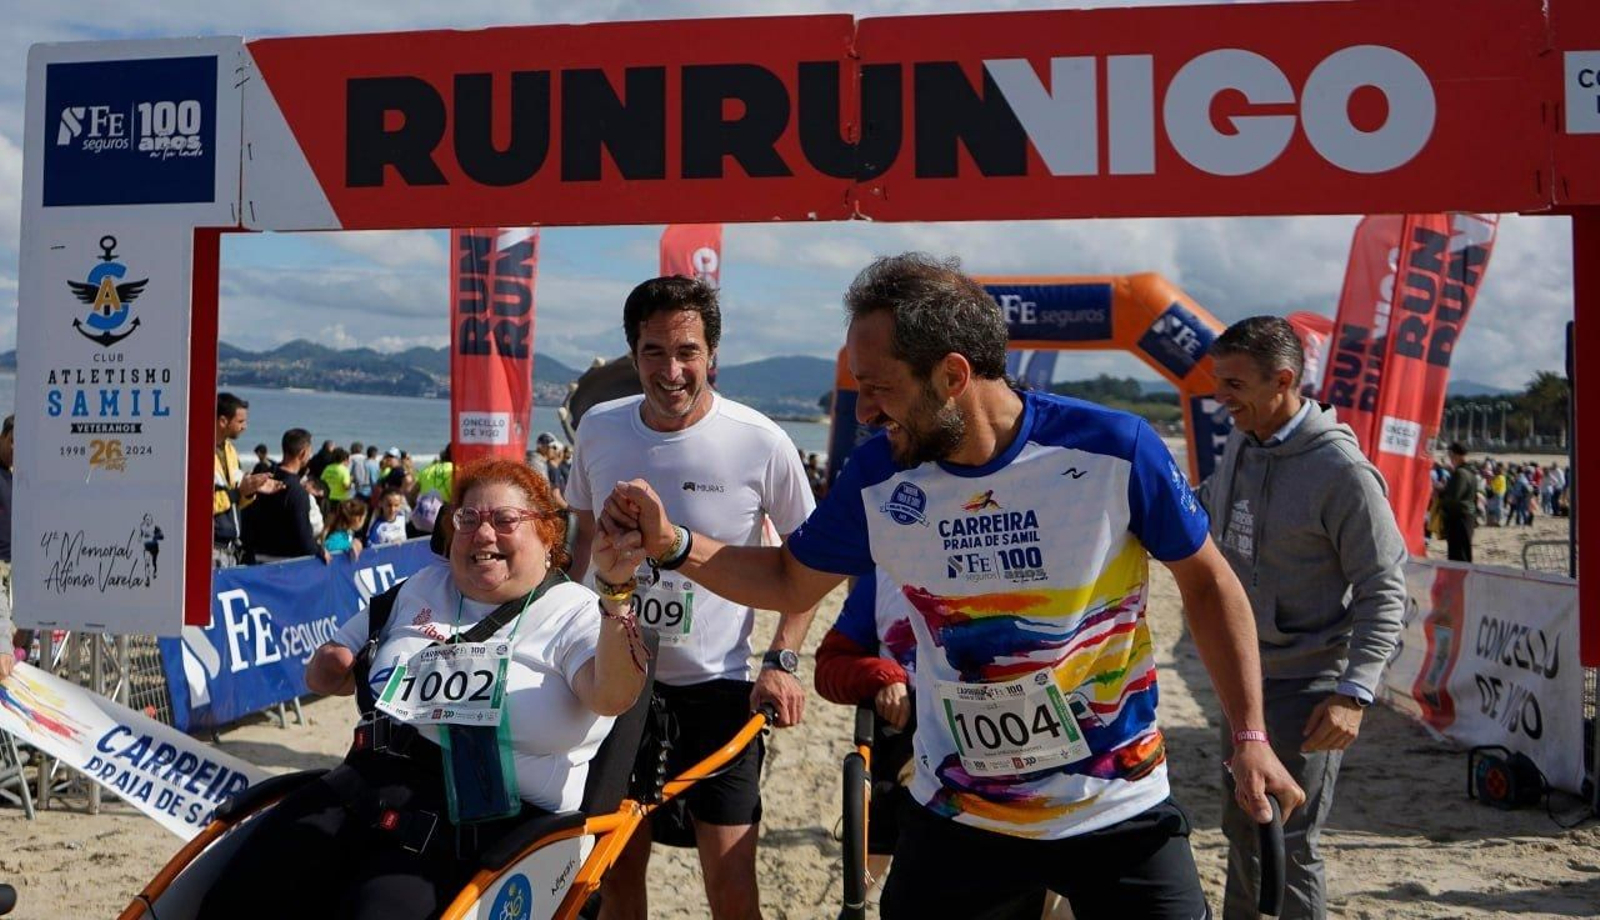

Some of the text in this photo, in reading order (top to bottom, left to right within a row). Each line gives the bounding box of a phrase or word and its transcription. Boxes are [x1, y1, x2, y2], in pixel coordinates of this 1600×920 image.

[138, 100, 201, 136] 100
[83, 137, 129, 153] seguros
[460, 235, 492, 356] RUN
[1396, 226, 1449, 360] RUN
[1040, 309, 1105, 328] seguros
[93, 353, 124, 362] CLUB
[1327, 323, 1370, 408] RUN
[48, 368, 171, 384] ATLETISMO
[48, 389, 170, 417] SAMIL
[77, 424, 136, 432] VETERANOS
[460, 418, 506, 427] ONCELLO
[464, 428, 475, 436] DE
[60, 446, 86, 455] 1998
[89, 439, 123, 465] 26
[126, 445, 153, 455] 2024
[938, 510, 1039, 537] CARREIRA
[60, 529, 135, 566] Memorial
[944, 531, 1040, 550] PRAIA DE SAMIL
[998, 547, 1043, 570] 100
[44, 558, 143, 594] Alfonso Varela
[632, 594, 683, 627] 009
[217, 588, 340, 673] FE seguros
[401, 670, 494, 702] 1002
[1475, 673, 1503, 718] DE
[955, 704, 1061, 749] 1004
[97, 725, 249, 804] CARREIR
[84, 757, 151, 804] PRAIA
[157, 788, 184, 817] DE
